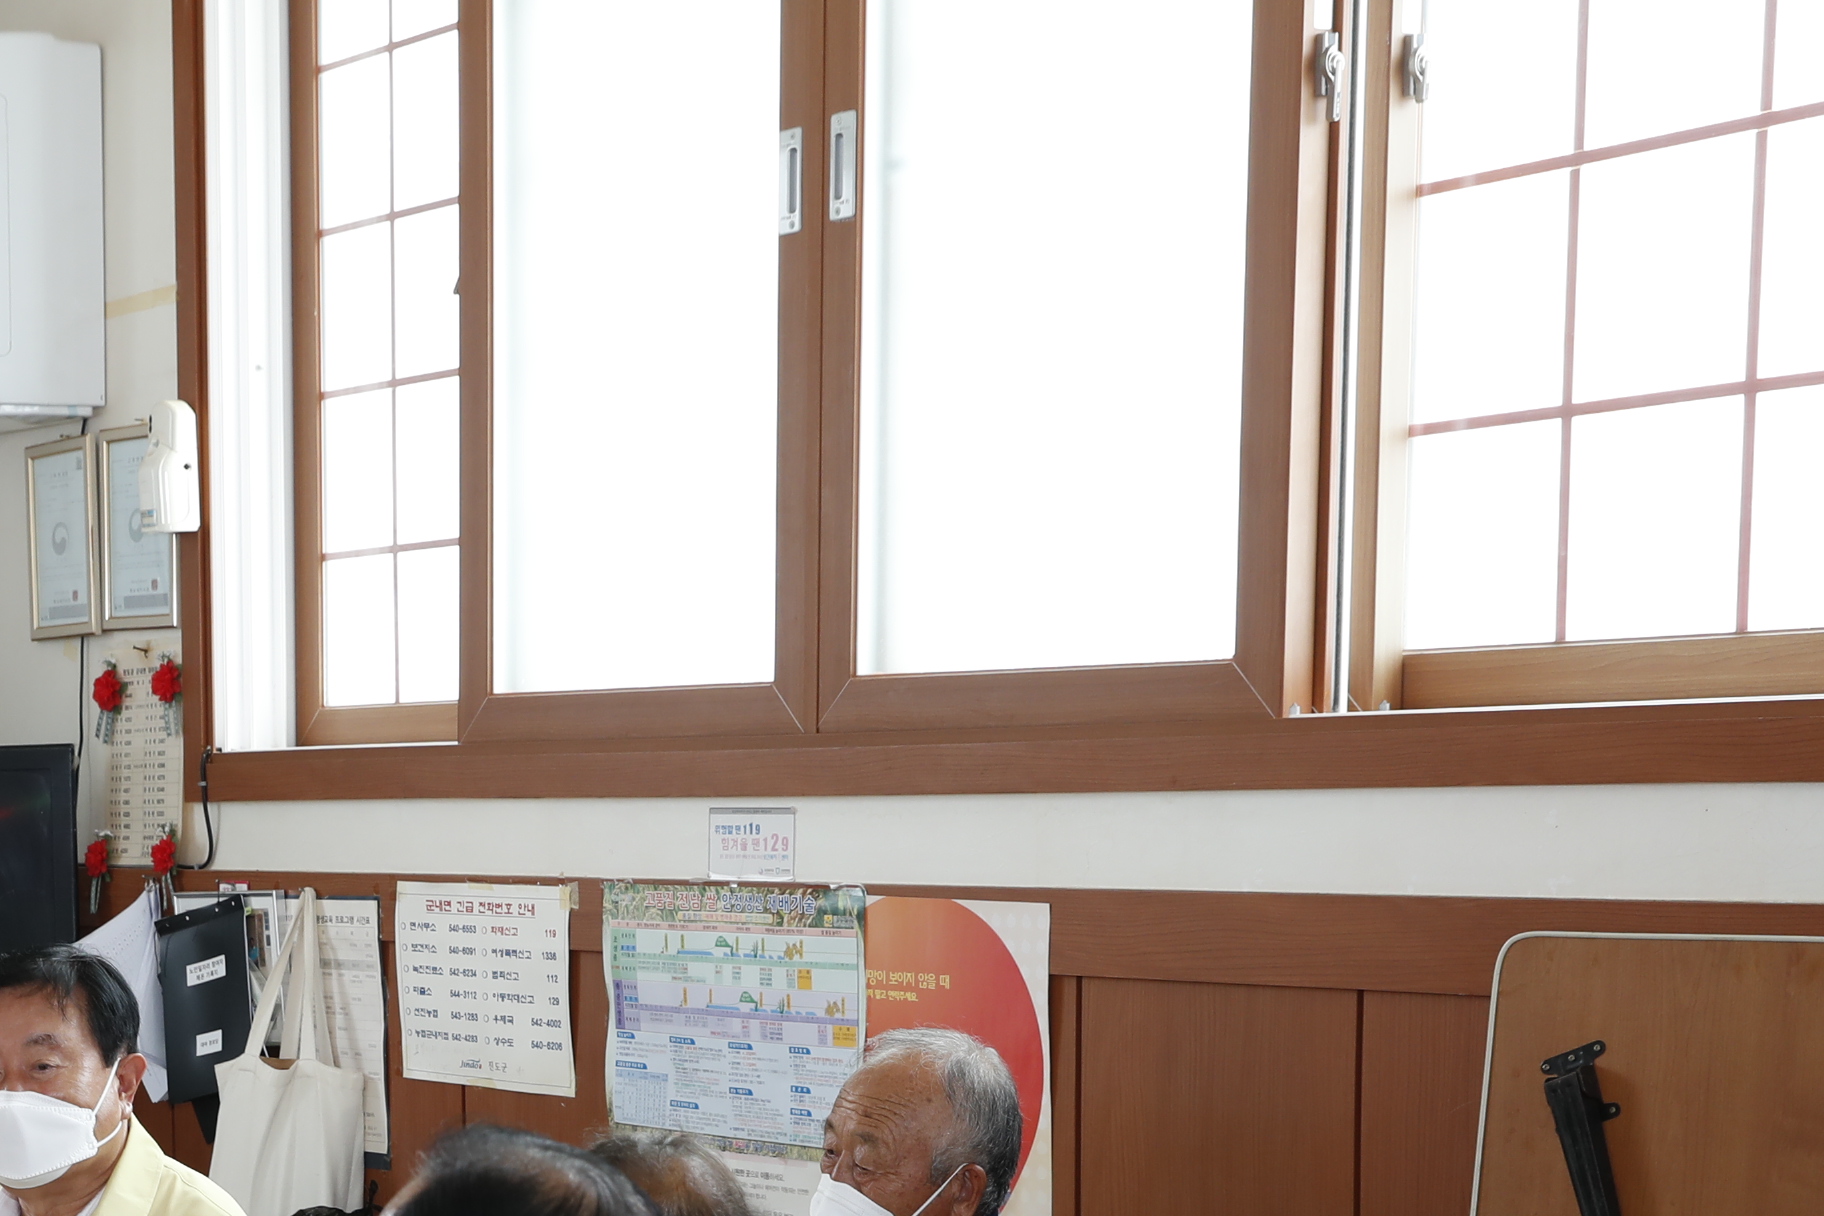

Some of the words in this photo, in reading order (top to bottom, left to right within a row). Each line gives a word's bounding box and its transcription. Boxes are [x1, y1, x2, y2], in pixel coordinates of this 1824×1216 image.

[743, 822, 761, 835] 119
[763, 833, 789, 852] 129
[426, 899, 452, 912] 군내면
[456, 900, 474, 913] 긴급
[478, 901, 513, 915] 전화번호
[517, 903, 536, 916] 안내
[644, 891, 675, 909] 고품질
[677, 892, 701, 910] 전남
[704, 893, 718, 911] 쌀
[721, 893, 764, 913] 안정생산
[767, 895, 817, 914] 재배기술
[335, 915, 355, 925] 프로그램
[356, 916, 371, 925] 시간표
[545, 929, 557, 938] 119
[546, 974, 559, 983] 112
[866, 969, 886, 985] 망이
[889, 971, 915, 987] 보이지
[918, 973, 936, 989] 않을
[939, 974, 950, 989] 때
[450, 989, 477, 999] 544-3112
[531, 1018, 562, 1028] 542-4002
[493, 1036, 514, 1047] 상수도
[531, 1040, 563, 1051] 540-6206
[488, 1061, 508, 1073] 진도군
